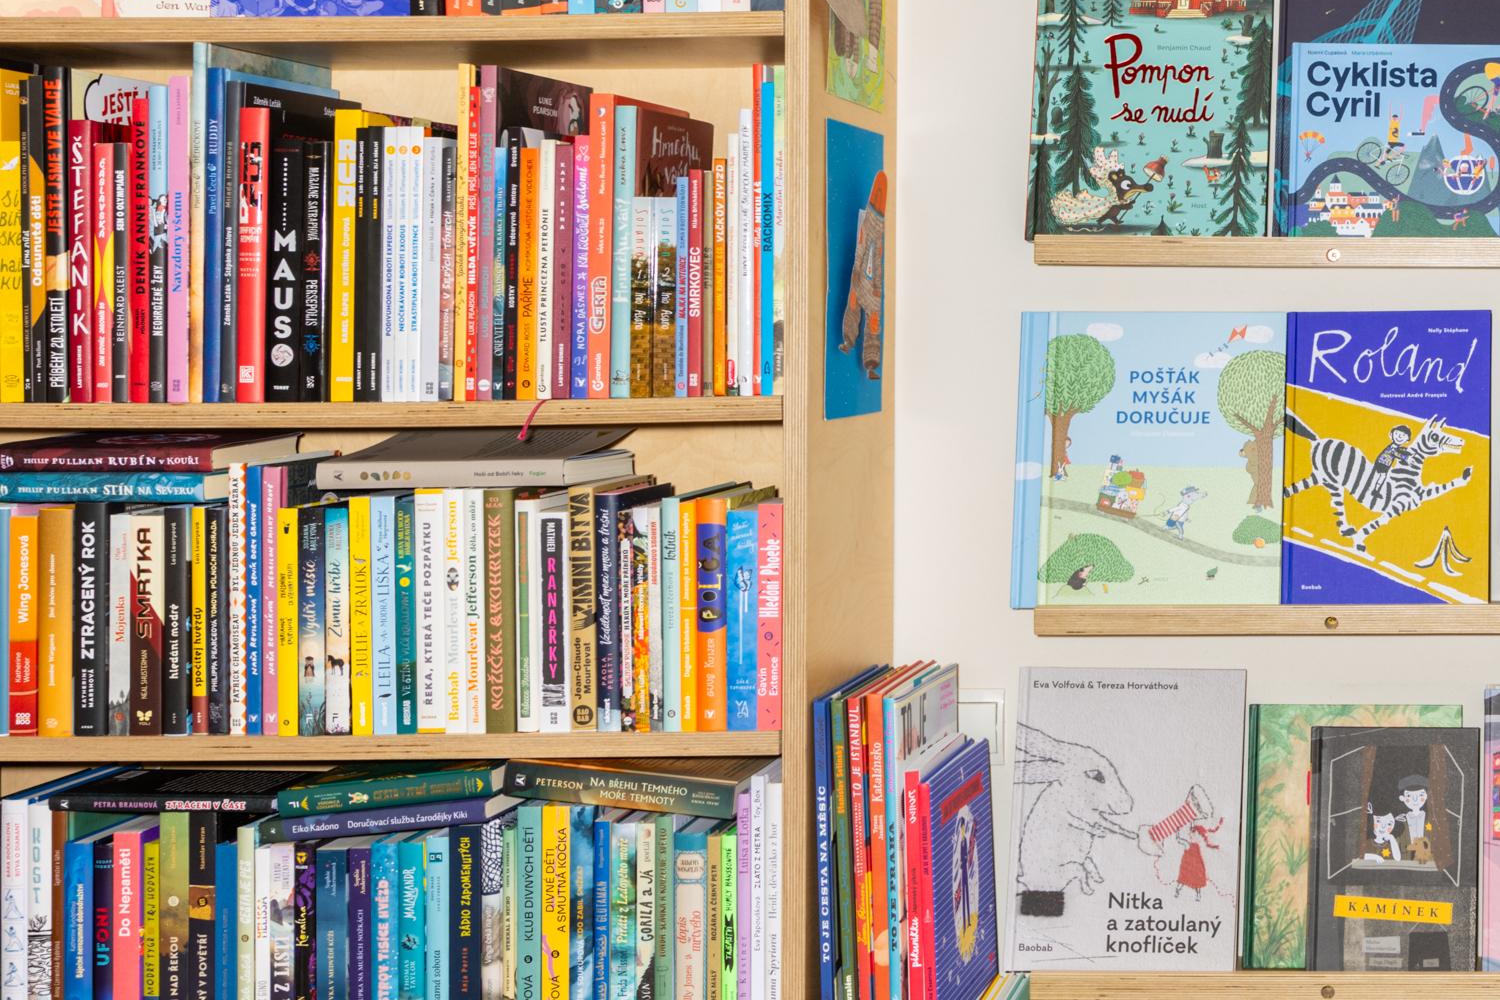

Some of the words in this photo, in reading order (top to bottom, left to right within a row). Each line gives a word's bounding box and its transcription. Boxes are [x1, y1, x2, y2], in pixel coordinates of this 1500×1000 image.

[1104, 33, 1214, 99] Pompon
[1307, 60, 1437, 92] Cyklista
[1110, 102, 1147, 123] se
[1152, 88, 1214, 123] nudí
[1306, 91, 1380, 122] Cyril
[134, 121, 146, 198] FRANKOVÉ
[71, 136, 89, 335] ŠTEFÁNIK
[135, 204, 146, 244] ANNE
[763, 192, 772, 253] RACKOMIX
[134, 251, 146, 294] DENÍK
[273, 230, 296, 338] MAUS
[689, 247, 700, 318] SMRKOVEC
[1130, 367, 1200, 384] POŠŤÁK
[1309, 326, 1478, 393] Roland
[1132, 387, 1195, 404] MYŠÁK
[1116, 408, 1210, 424] DORUČUJE
[52, 457, 102, 465] PULLMAN
[108, 455, 156, 466] RUBÍN
[167, 456, 199, 466] KOUŘI
[569, 491, 592, 551] BITVA
[81, 521, 95, 562] ROK
[761, 539, 780, 575] Phoebe
[18, 535, 29, 592] Jonesová
[137, 528, 151, 639] SMRTKA
[568, 556, 592, 617] ZIMNÍ
[759, 581, 780, 618] Hledání
[18, 595, 31, 624] Wing
[80, 566, 94, 659] ZTRACENÝ
[547, 557, 558, 680] RANAŘKY
[1052, 680, 1084, 689] Volfová
[1096, 682, 1124, 690] Tereza
[1128, 682, 1178, 690] Horváthová
[536, 777, 583, 790] PETERSON
[589, 777, 605, 787] NA
[608, 776, 637, 792] BŘEHU
[642, 782, 689, 796] TEMNÉHO
[872, 742, 882, 803] Katalánsko
[120, 800, 158, 809] BRAUNOVÁ
[213, 801, 219, 810] V
[222, 799, 246, 811] ČASE
[600, 789, 626, 801] MOŘE
[629, 791, 675, 805] TEMNOTY
[1108, 892, 1163, 910] Nitka
[1348, 900, 1438, 918] KAMÍNEK
[1107, 919, 1117, 930] a
[1125, 914, 1222, 938] zatoulaný
[1018, 944, 1052, 952] Baobab
[1106, 935, 1198, 954] knoflíček
